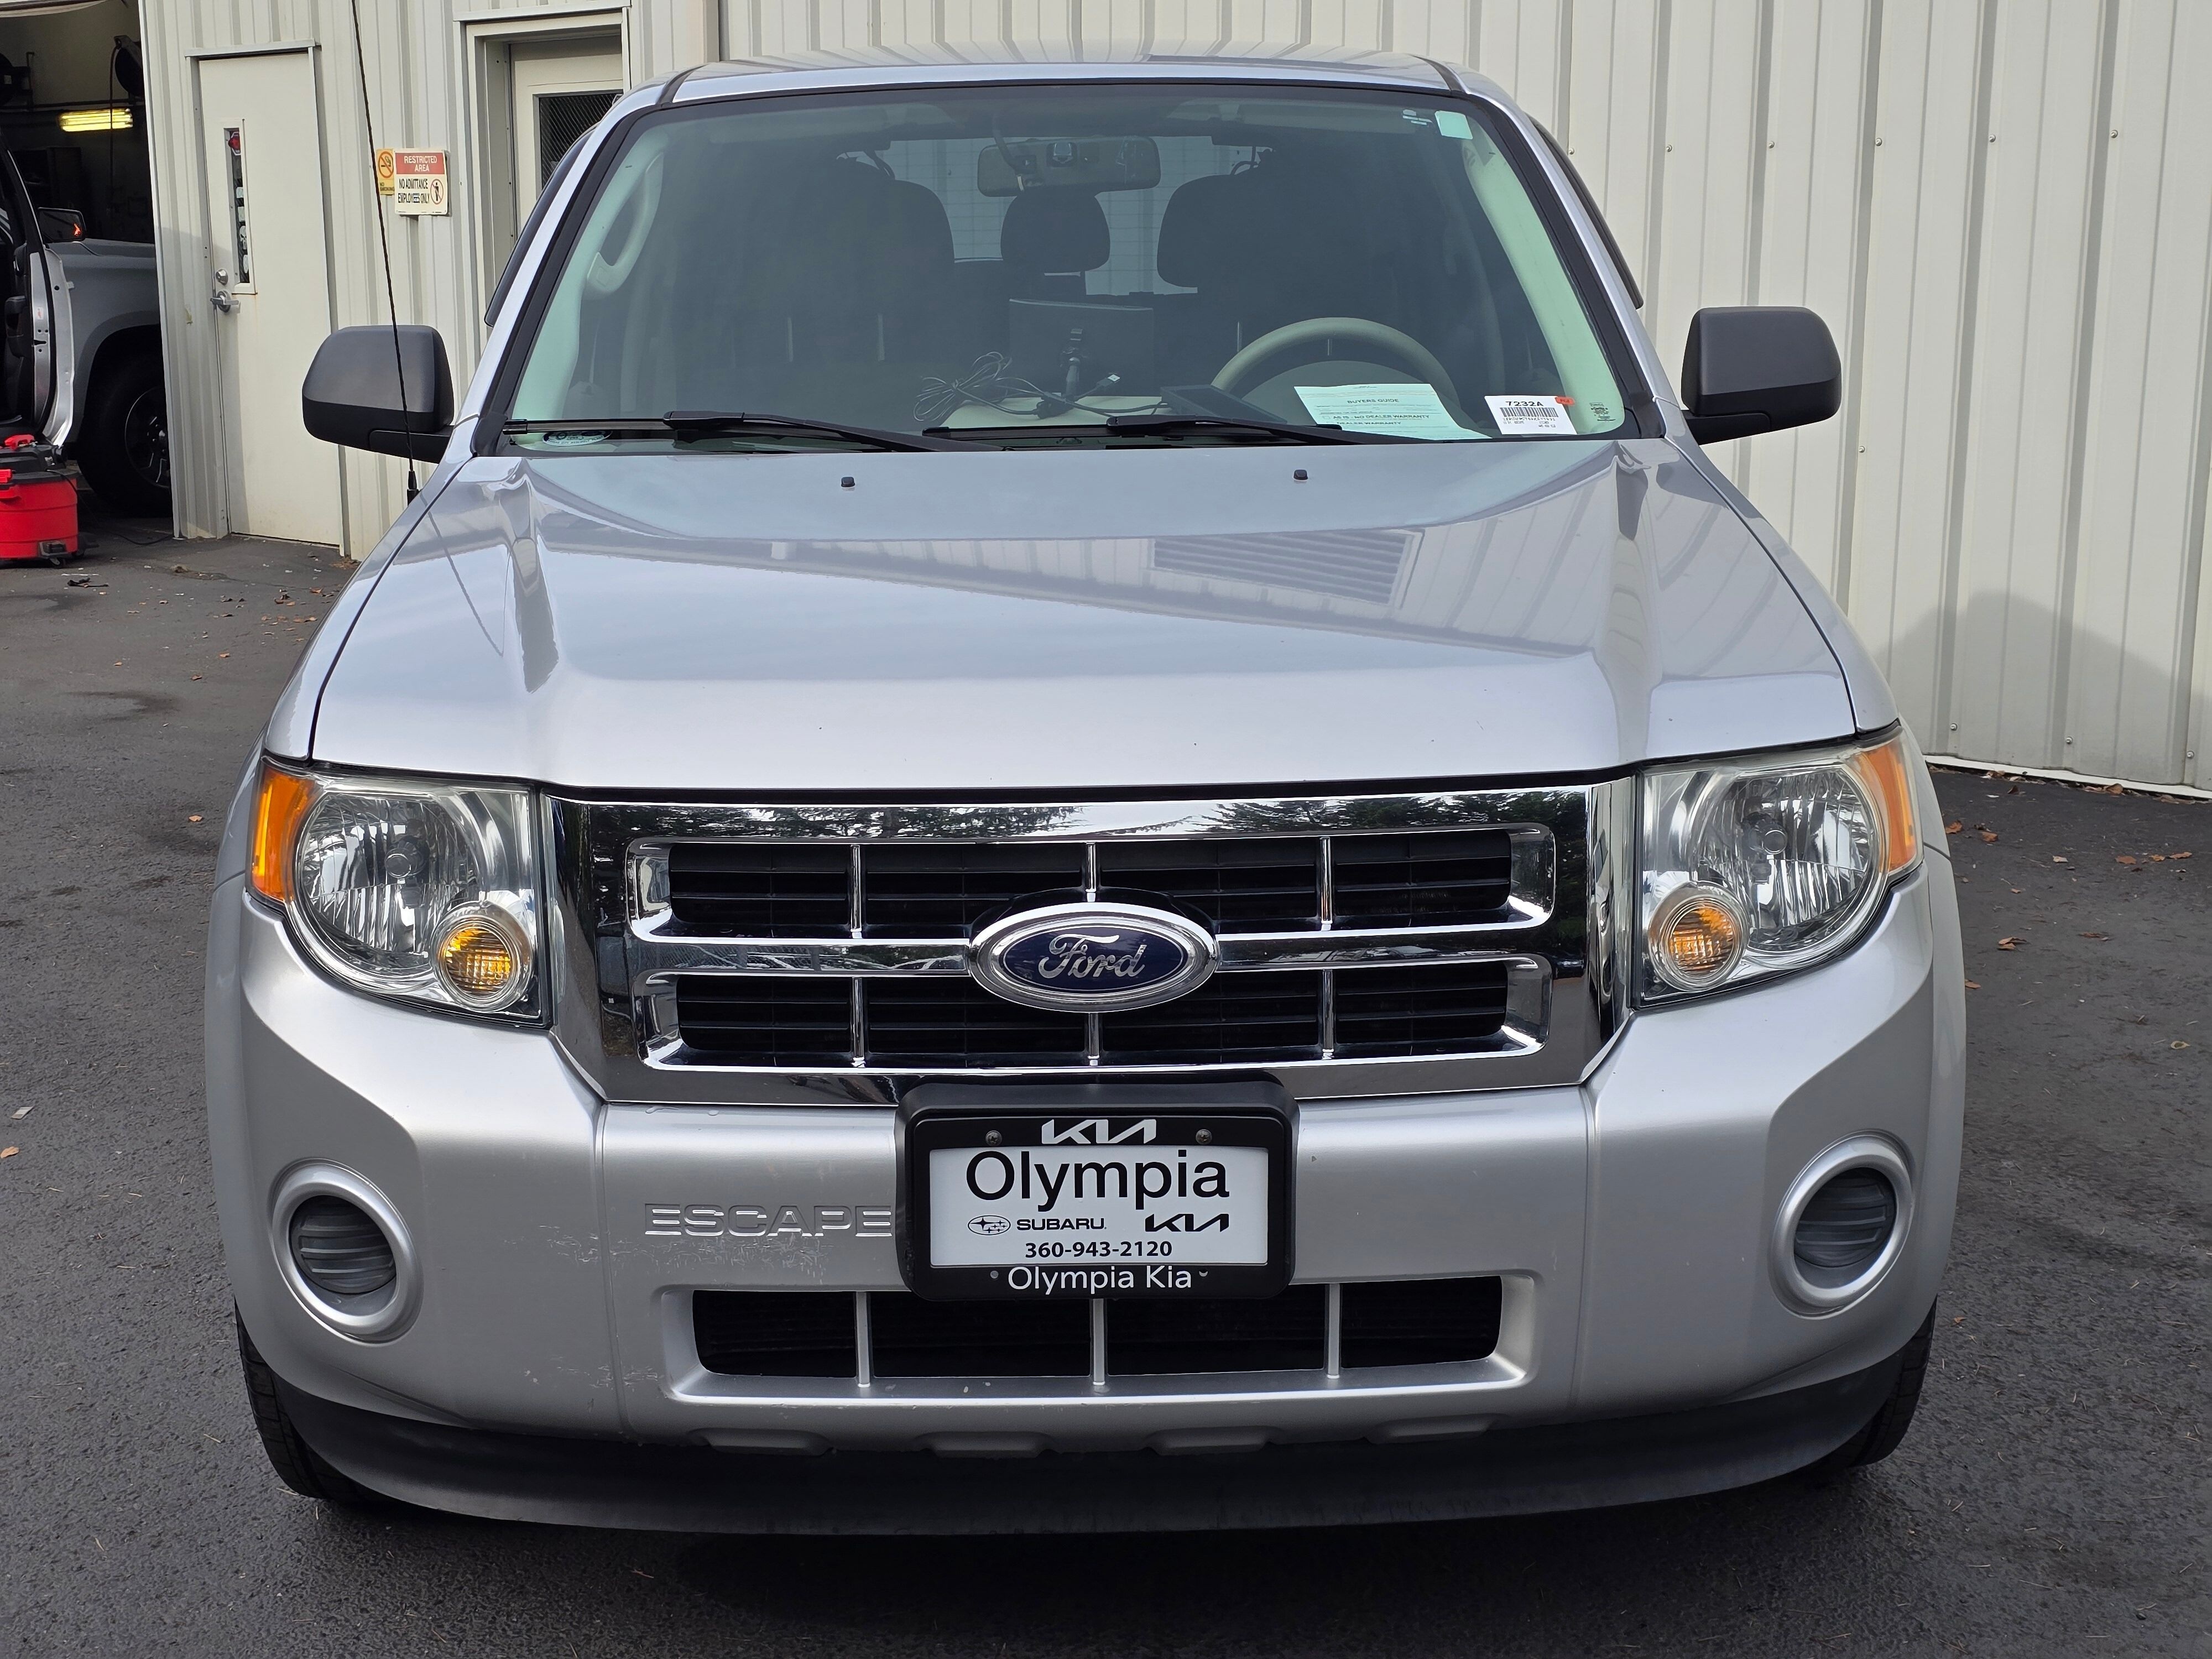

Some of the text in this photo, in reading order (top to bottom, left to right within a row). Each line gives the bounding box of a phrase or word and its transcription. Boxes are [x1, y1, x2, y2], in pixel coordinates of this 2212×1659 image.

[404, 155, 437, 164] RESTRICTED
[399, 179, 428, 189] NO ADMITTANCE
[398, 193, 430, 204] EMPLOYEES ONLY
[1038, 933, 1147, 979] Ford
[1042, 1119, 1157, 1144] KIA
[966, 1149, 1230, 1212] Olympia
[645, 1203, 892, 1237] ESCAPE
[1016, 1213, 1229, 1232] SUBARU KIA
[1025, 1241, 1173, 1258] 360-943-2120
[1008, 1264, 1192, 1295] Olympia Kia
